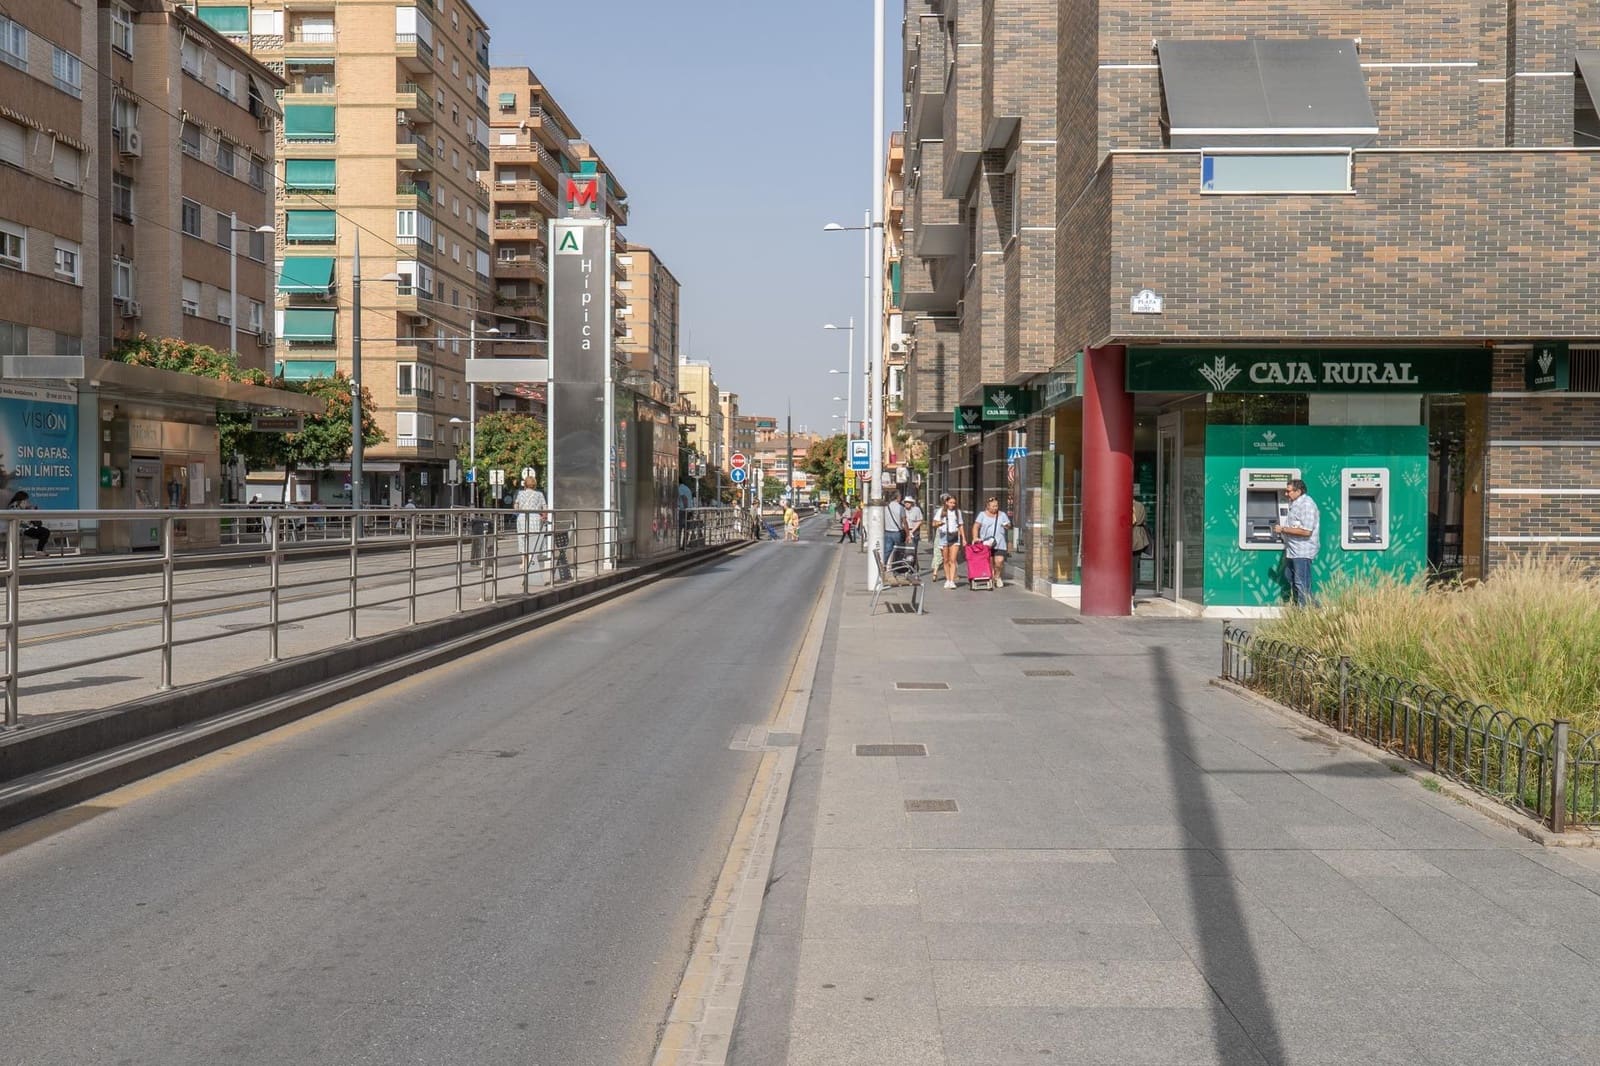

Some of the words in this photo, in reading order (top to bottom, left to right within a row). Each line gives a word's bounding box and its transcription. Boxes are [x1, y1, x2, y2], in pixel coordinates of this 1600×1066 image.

[566, 179, 597, 210] M
[559, 230, 579, 251] A
[581, 259, 592, 350] Hípica
[1249, 362, 1316, 385] CAJA
[1322, 362, 1418, 384] RURAL
[17, 445, 34, 458] SIN
[37, 447, 70, 460] GAFAS.
[15, 464, 32, 477] SIN
[34, 462, 72, 476] LÍMITES.
